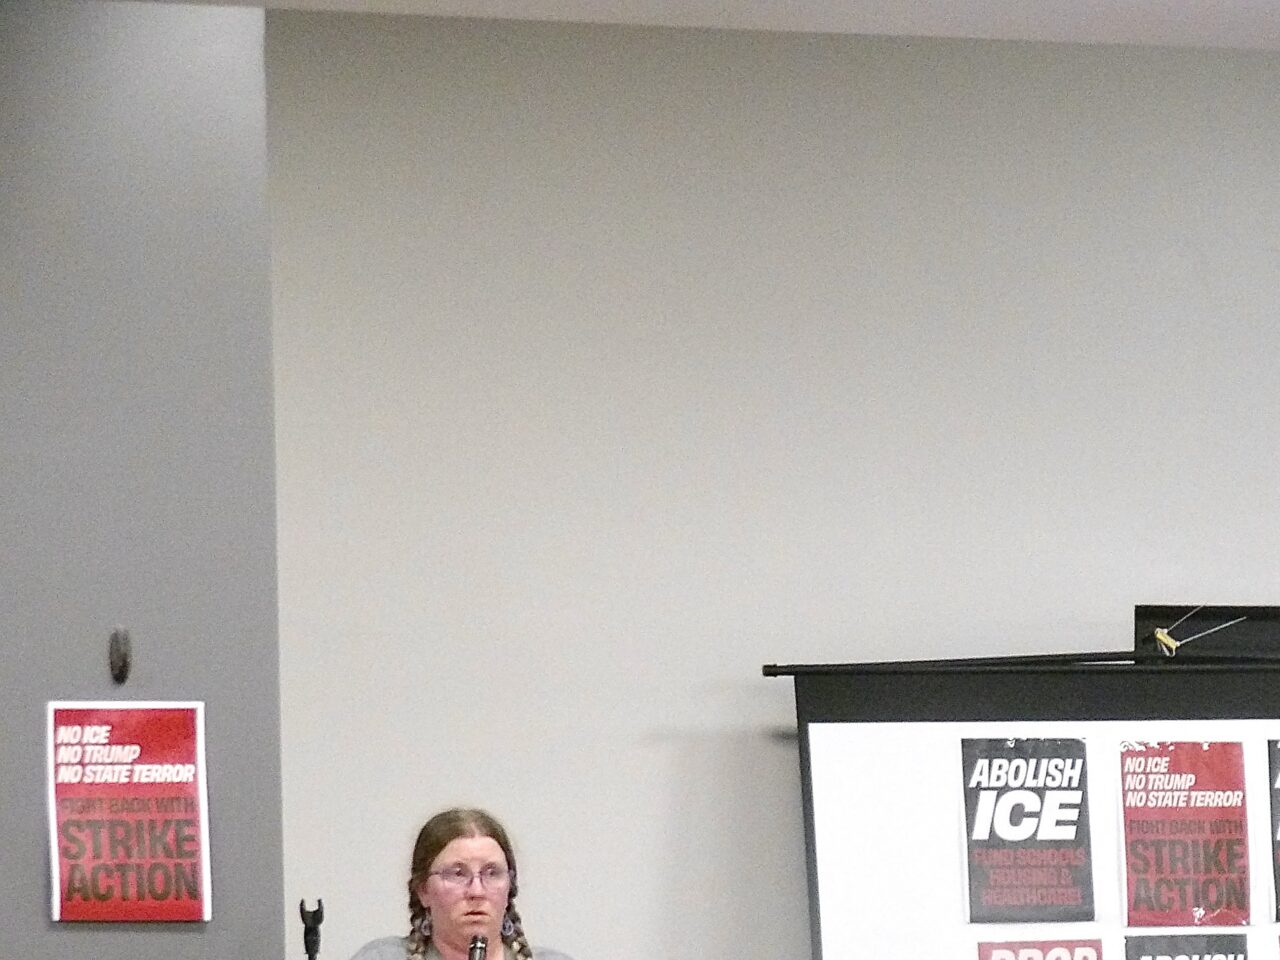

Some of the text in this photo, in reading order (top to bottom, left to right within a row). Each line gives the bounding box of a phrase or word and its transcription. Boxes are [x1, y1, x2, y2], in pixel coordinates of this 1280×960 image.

[56, 725, 112, 743] NO ICE
[56, 745, 141, 763] NO TRUMP
[1124, 757, 1170, 773] NO ICE
[57, 764, 195, 783] NO STATE TERROR
[968, 758, 1083, 788] ABOLISH
[1125, 774, 1196, 790] NO TRUMP
[1126, 791, 1243, 808] NO STATE TERROR
[972, 789, 1083, 841] ICE
[62, 819, 196, 860] STRIKE
[1130, 838, 1246, 875] STRIKE
[66, 862, 199, 902] ACTION
[1132, 876, 1247, 912] ACTION
